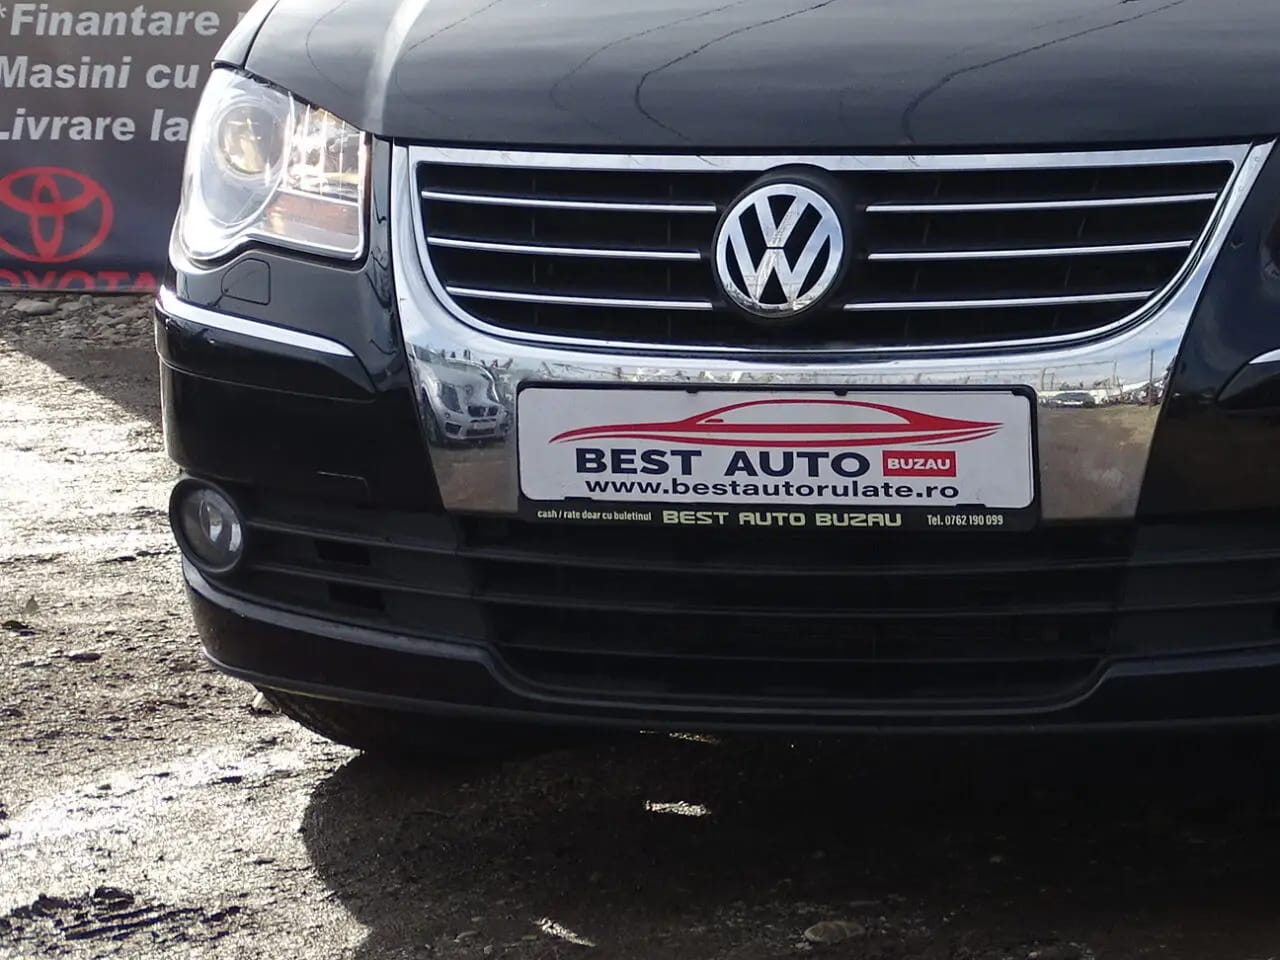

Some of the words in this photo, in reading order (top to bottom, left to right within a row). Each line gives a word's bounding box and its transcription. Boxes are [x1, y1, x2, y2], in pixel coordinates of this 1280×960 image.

[146, 64, 200, 89] cu
[0, 108, 136, 141] ivrare
[151, 108, 191, 141] la
[575, 448, 702, 476] BEST
[724, 451, 871, 478] AUTO
[887, 458, 951, 470] BUZAU
[585, 478, 960, 498] www.bestautorulate.ro
[563, 511, 581, 520] rate
[581, 511, 601, 521] doar
[602, 513, 613, 521] cu
[613, 511, 652, 522] buletinul
[662, 510, 730, 525] BEST
[739, 512, 806, 526] AUTO
[815, 512, 902, 527] BUZAU
[927, 514, 944, 525] Tel.
[944, 514, 968, 526] 0762
[968, 515, 985, 526] 190
